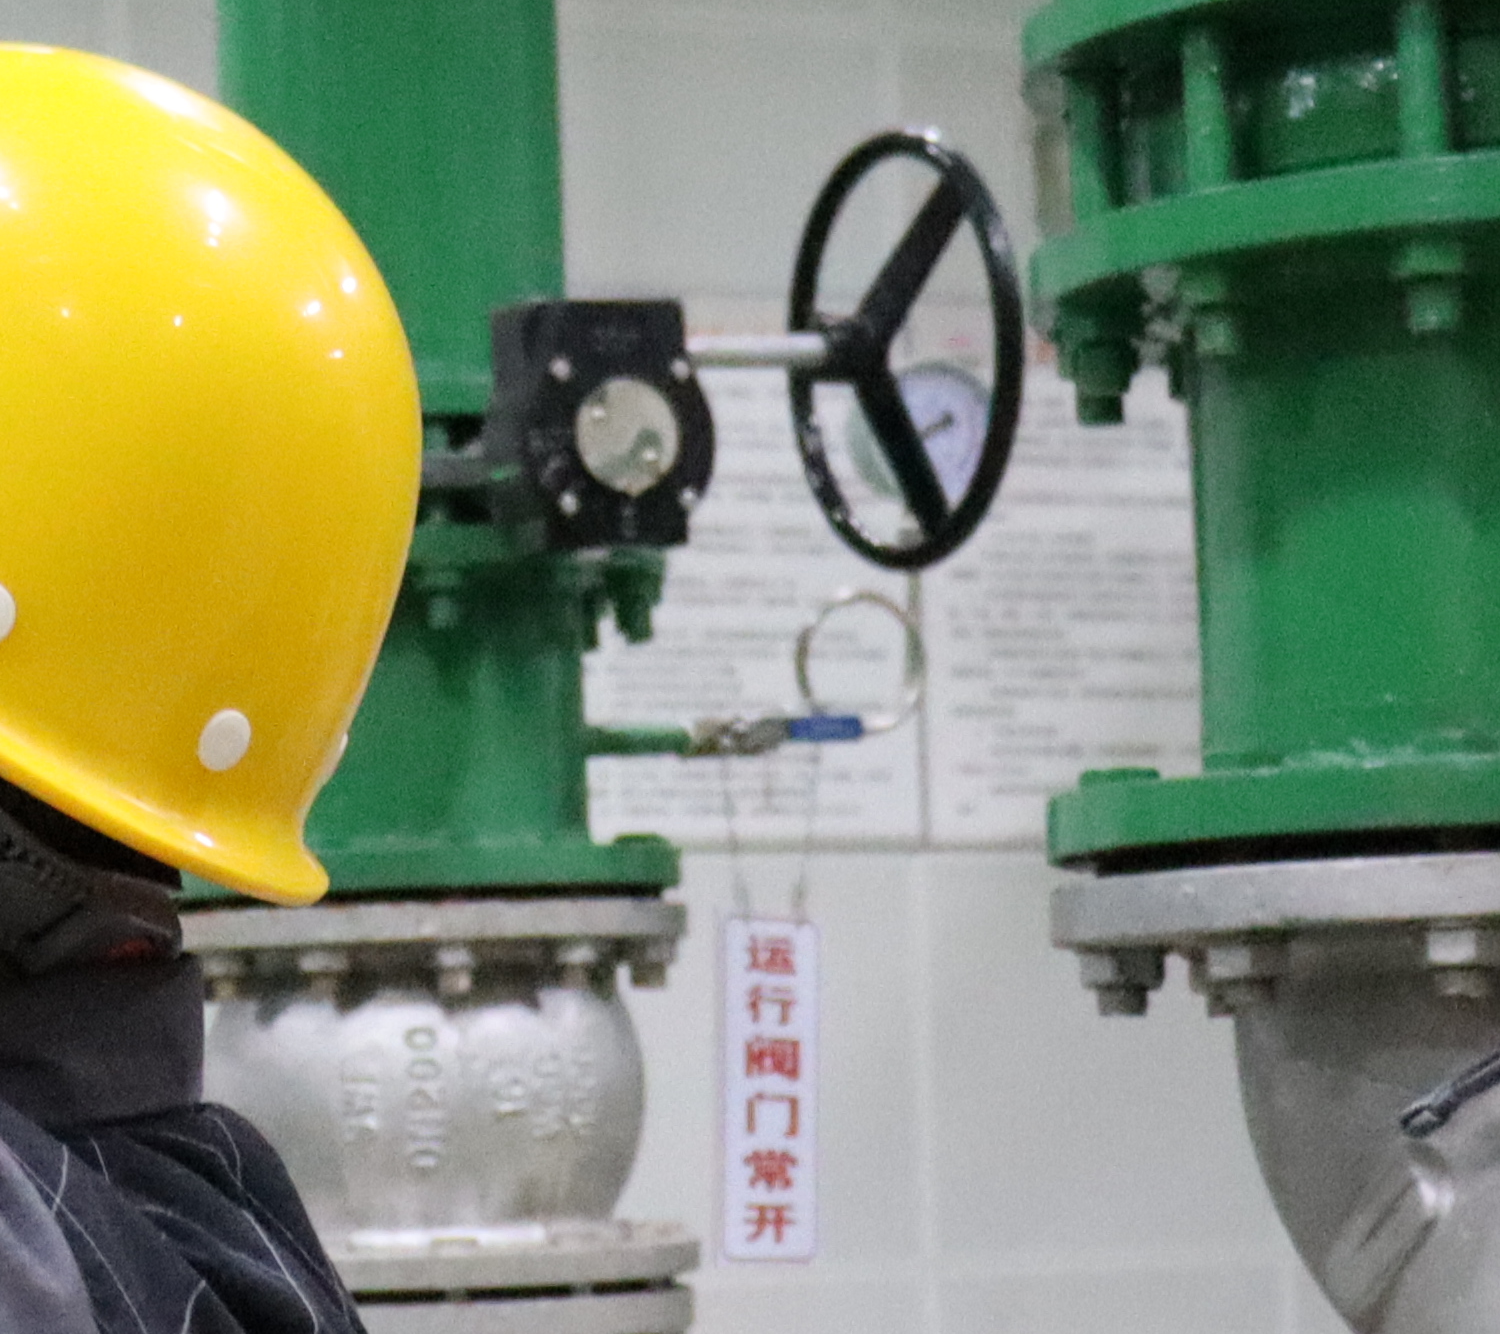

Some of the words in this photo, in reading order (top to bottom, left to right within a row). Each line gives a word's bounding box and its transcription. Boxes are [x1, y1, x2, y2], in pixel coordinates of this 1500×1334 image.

[743, 934, 802, 1245] 运行阀门常开
